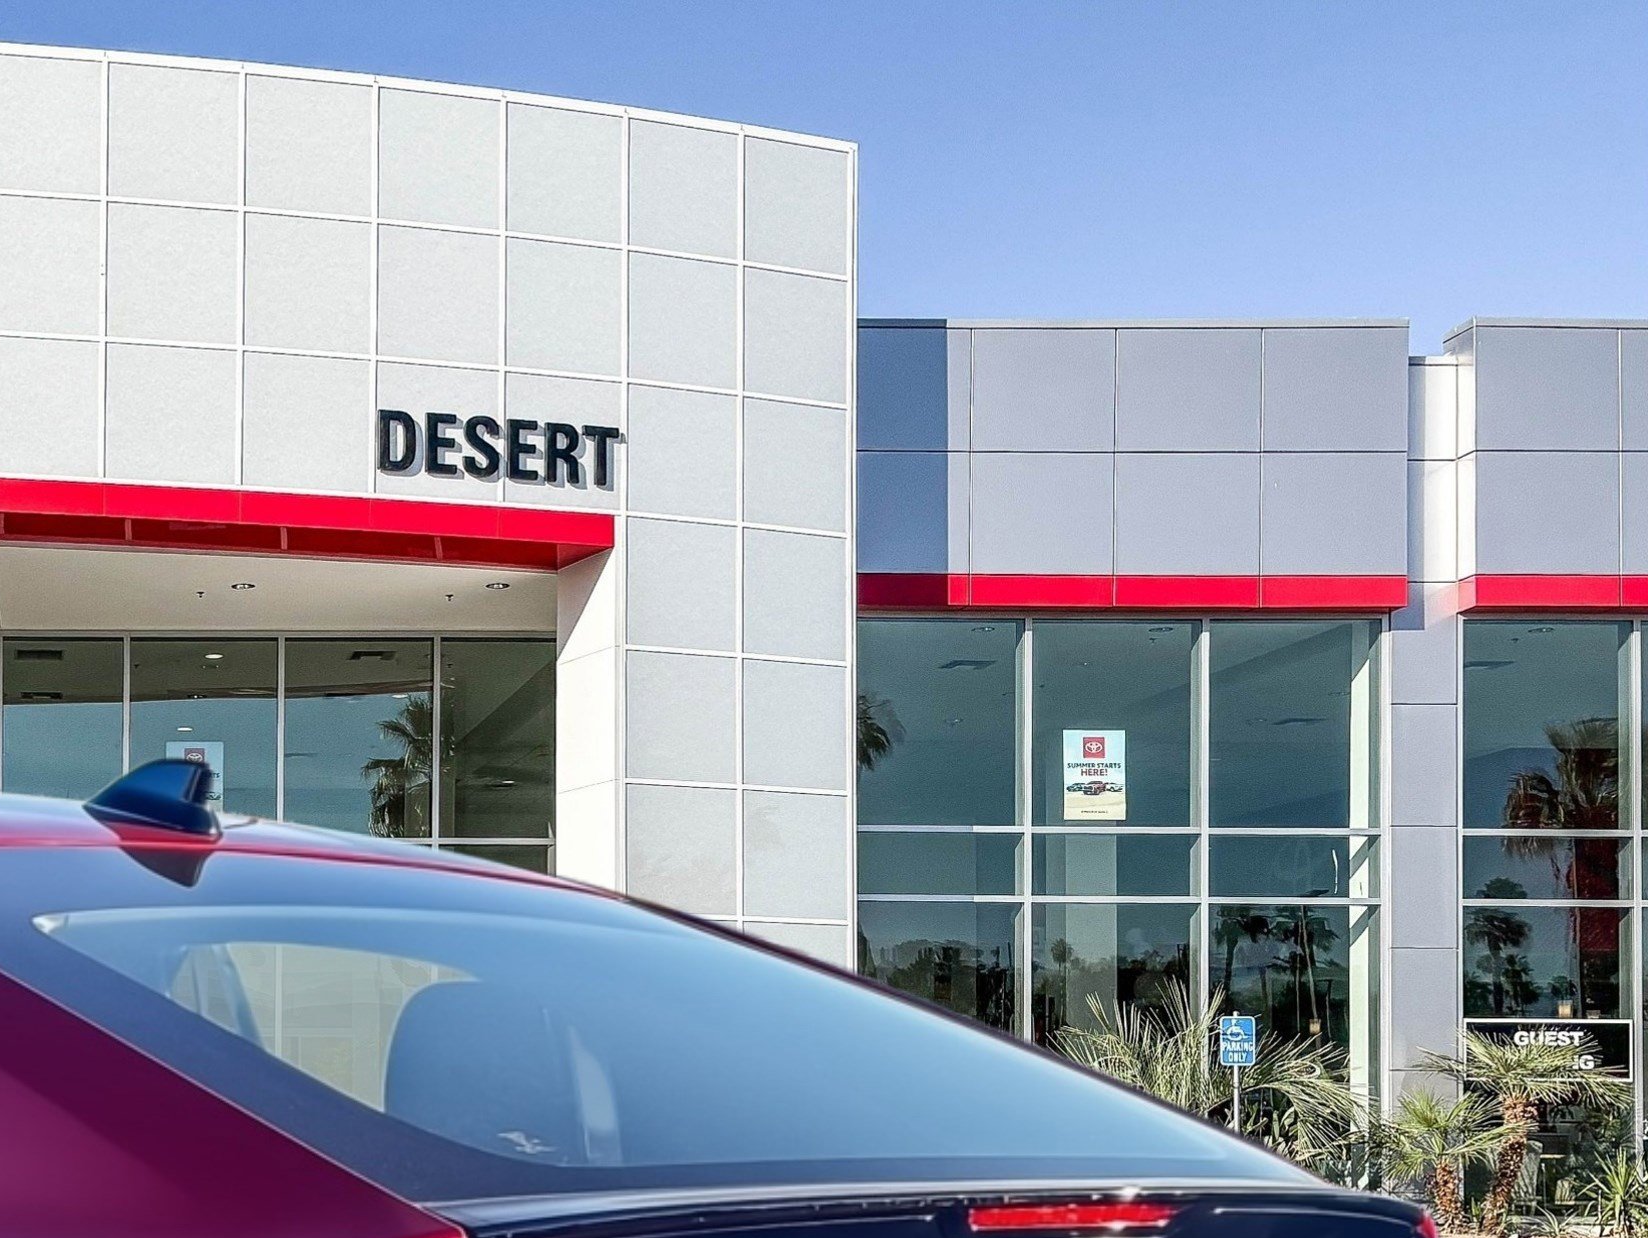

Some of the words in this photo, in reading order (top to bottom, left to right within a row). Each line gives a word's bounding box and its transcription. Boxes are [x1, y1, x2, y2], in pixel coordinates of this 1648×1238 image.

[376, 409, 620, 487] DESERT
[1080, 769, 1108, 777] HERE!
[1513, 1030, 1585, 1046] GUEST
[1222, 1041, 1254, 1052] PARKING
[1228, 1052, 1247, 1063] ONLY
